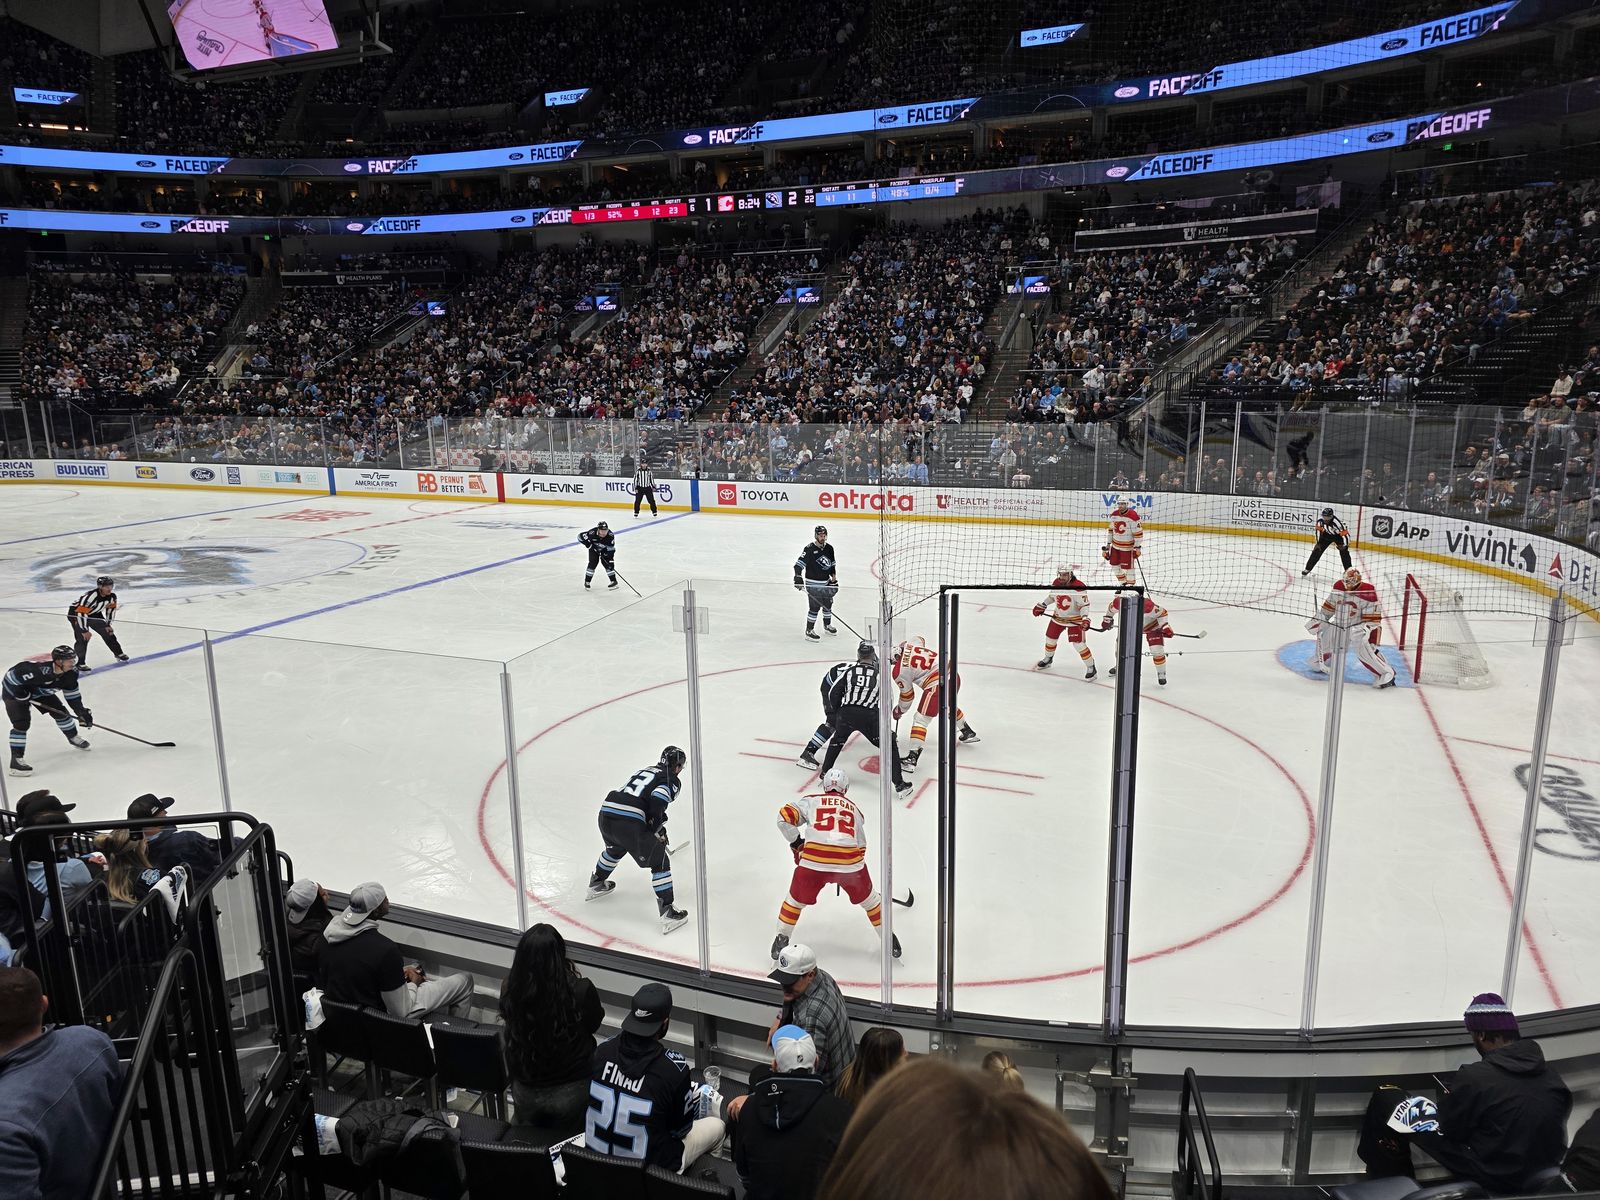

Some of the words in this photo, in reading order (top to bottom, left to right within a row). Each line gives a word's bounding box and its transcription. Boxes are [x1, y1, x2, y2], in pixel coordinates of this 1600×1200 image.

[1420, 8, 1509, 47] FACEOFF
[1148, 70, 1224, 97] FACEOFF
[907, 103, 970, 123] FACEOFF
[1406, 108, 1492, 141] FACEOFF
[709, 125, 764, 145] FACEOFF
[531, 144, 578, 161] FACEOFF
[166, 159, 225, 173] FACEOFF
[368, 159, 418, 173] FACEOFF
[1141, 154, 1213, 176] FACEOFF
[705, 197, 711, 211] 1
[738, 198, 760, 210] 8:24
[788, 191, 797, 205] 2
[804, 195, 814, 203] 22
[825, 194, 835, 202] 41
[847, 192, 856, 201] 11
[532, 210, 572, 225] FACEOF
[584, 212, 596, 220] 1/3
[607, 211, 622, 219] 52%
[633, 209, 639, 217] 9
[652, 208, 660, 216] 12
[690, 204, 695, 212] 6
[170, 219, 229, 233] FACEOFF
[372, 219, 421, 232] FACEOFF
[1198, 226, 1229, 236] HEALTH
[0, 470, 35, 478] PRESS
[57, 465, 78, 475] BUD
[79, 465, 106, 476] LIGHT
[194, 470, 211, 479] Ford
[440, 475, 464, 484] PEANUT
[441, 485, 465, 493] BETTER
[532, 482, 584, 494] FILEVINE
[740, 490, 789, 502] TOYOTA
[818, 489, 914, 512] entrata
[954, 497, 989, 506] HEALTH
[1237, 499, 1263, 508] JUST
[1237, 508, 1314, 524] INGREDIENTS
[1570, 560, 1600, 597] DEL
[910, 646, 938, 671] 23
[22, 672, 34, 681] 2
[856, 675, 871, 687] 91
[813, 807, 855, 838] 52
[1394, 1100, 1411, 1121] UTAH
[585, 1079, 653, 1160] 25
